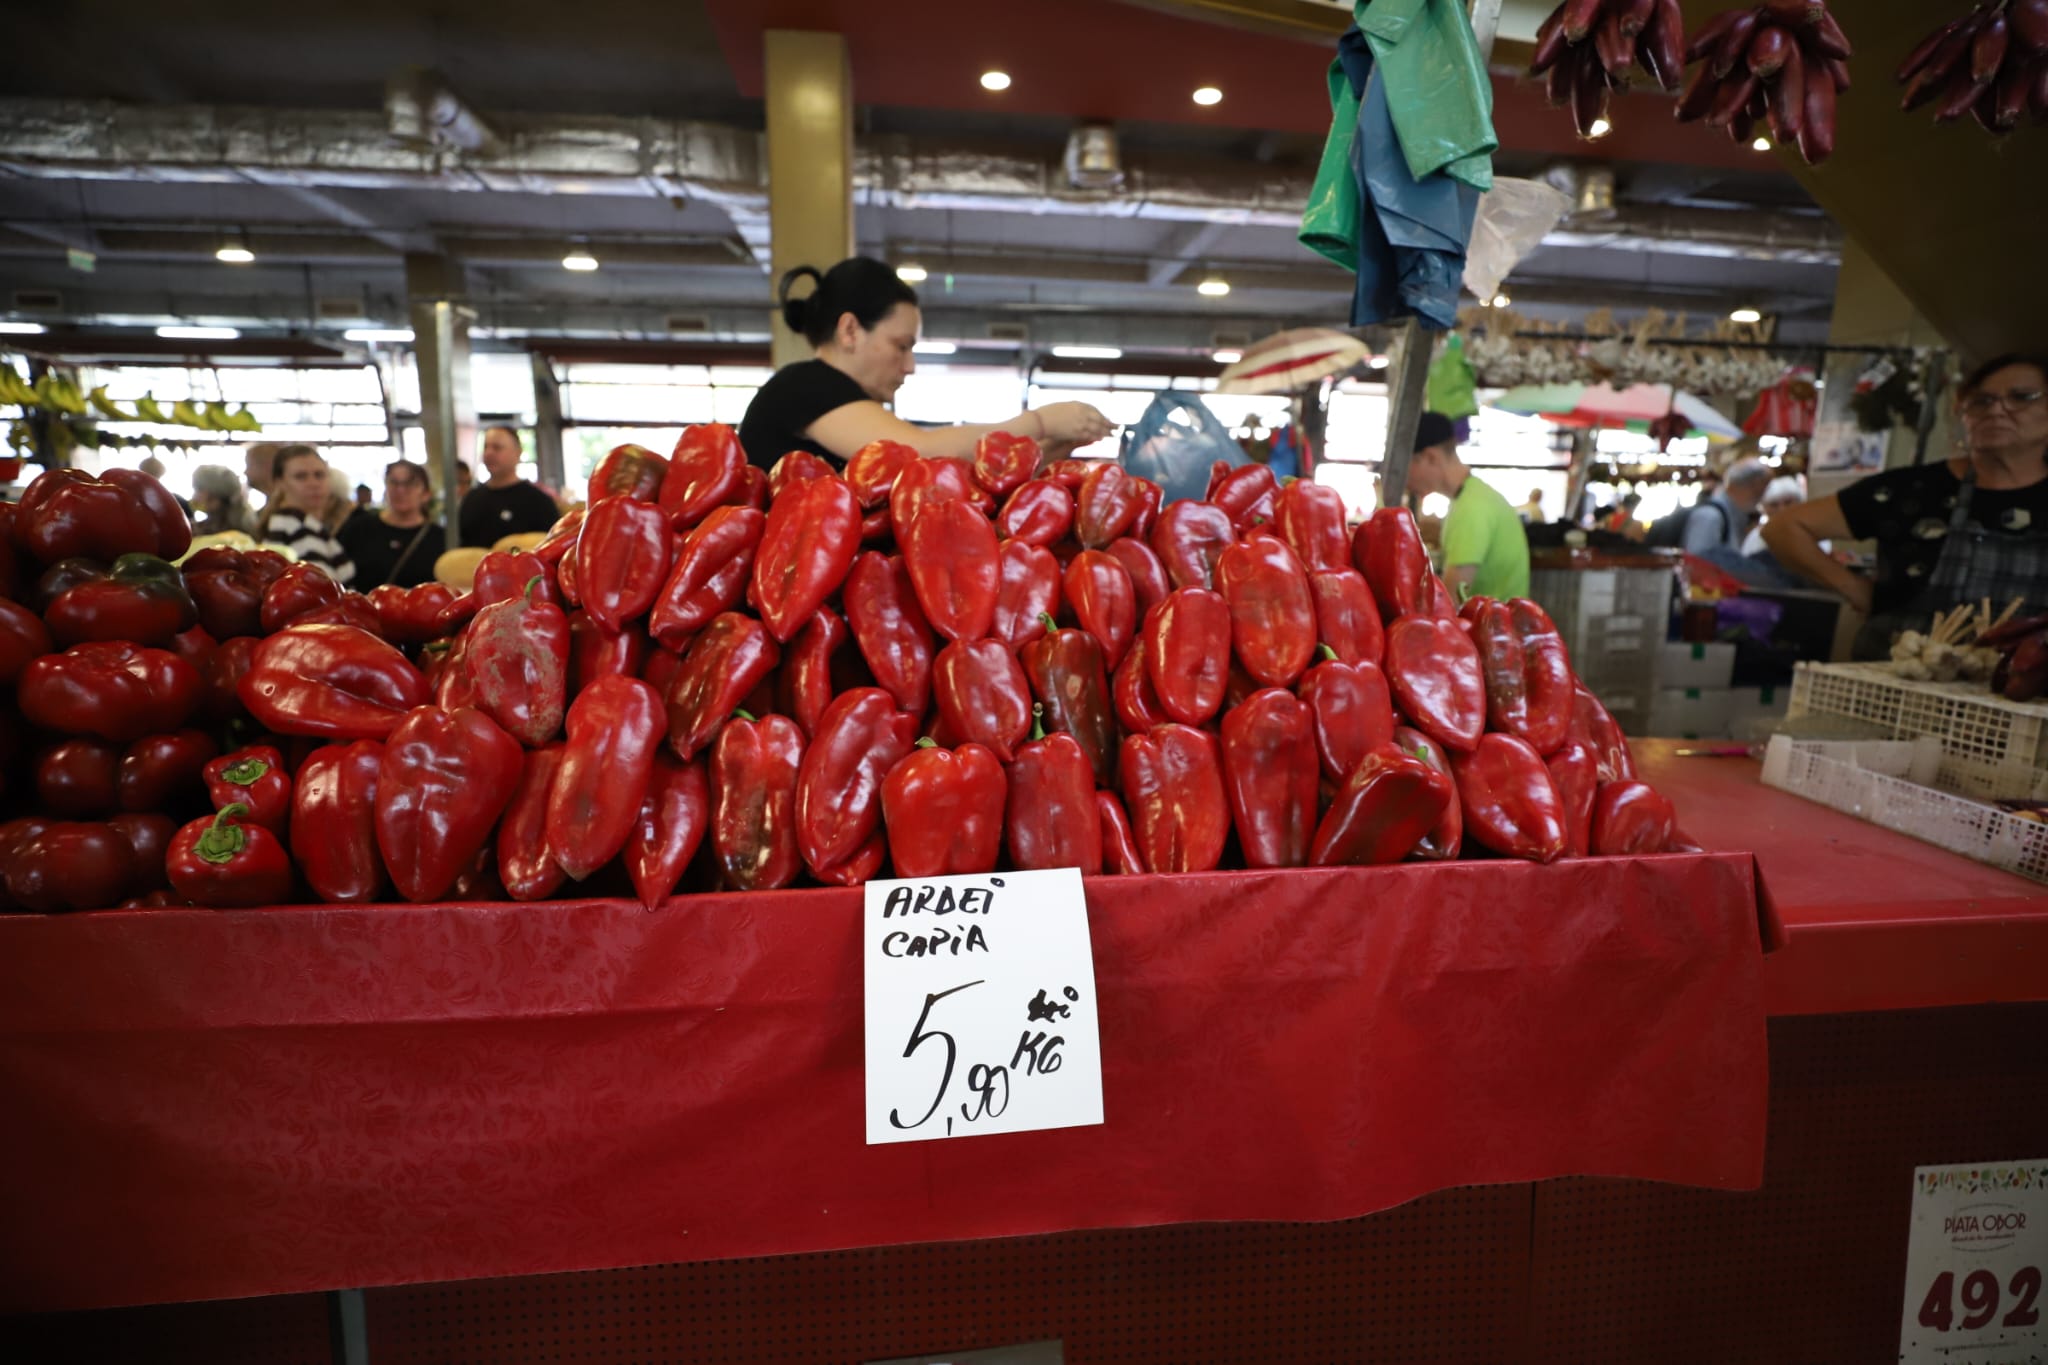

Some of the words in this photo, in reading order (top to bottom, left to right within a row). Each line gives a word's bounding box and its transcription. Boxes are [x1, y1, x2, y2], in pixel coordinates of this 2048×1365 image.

[883, 877, 1005, 918] ARDEI
[1010, 1031, 1065, 1076] KG
[1918, 1266, 2042, 1332] 492
